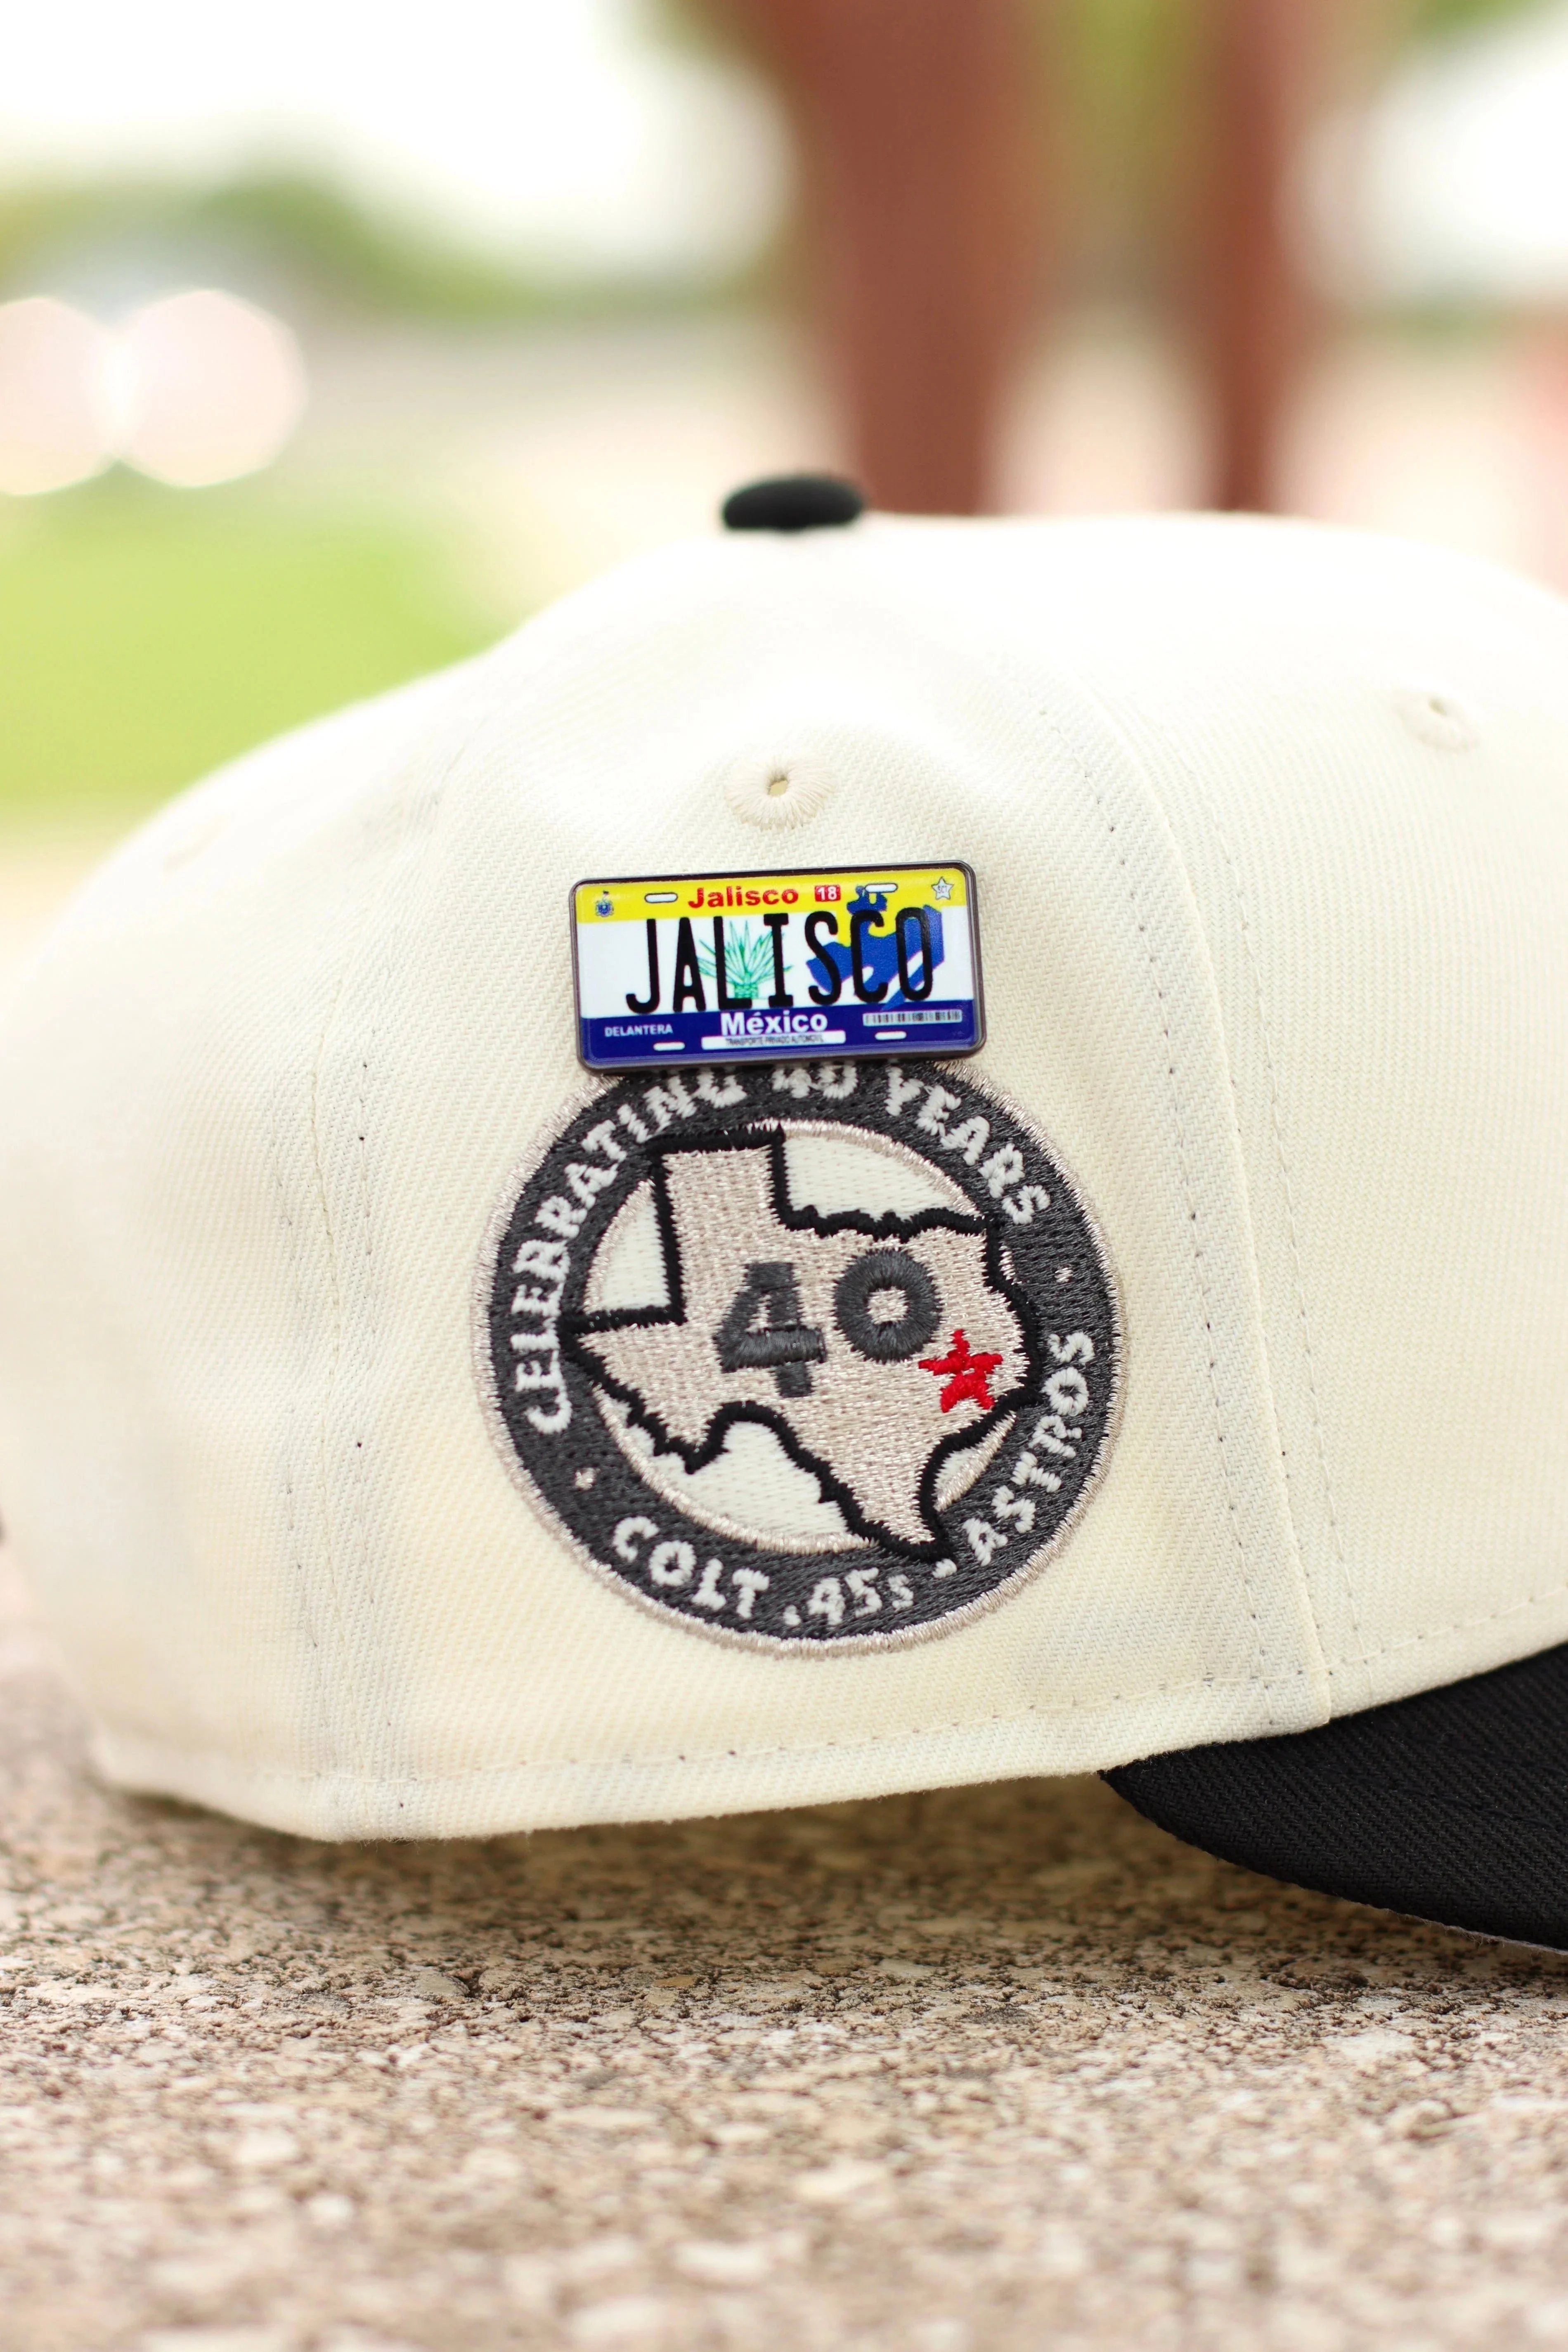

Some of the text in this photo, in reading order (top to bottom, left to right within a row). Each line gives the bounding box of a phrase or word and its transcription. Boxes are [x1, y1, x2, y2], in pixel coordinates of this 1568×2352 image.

[688, 885, 837, 908] Jalisco 18
[626, 907, 933, 1014] JALISCO
[604, 1024, 673, 1037] DELANTERA
[720, 1010, 828, 1036] México
[885, 1065, 1050, 1225] YEARS
[712, 1247, 943, 1397] 40
[612, 1516, 770, 1619] COLT
[963, 1331, 1095, 1566] ASTROS
